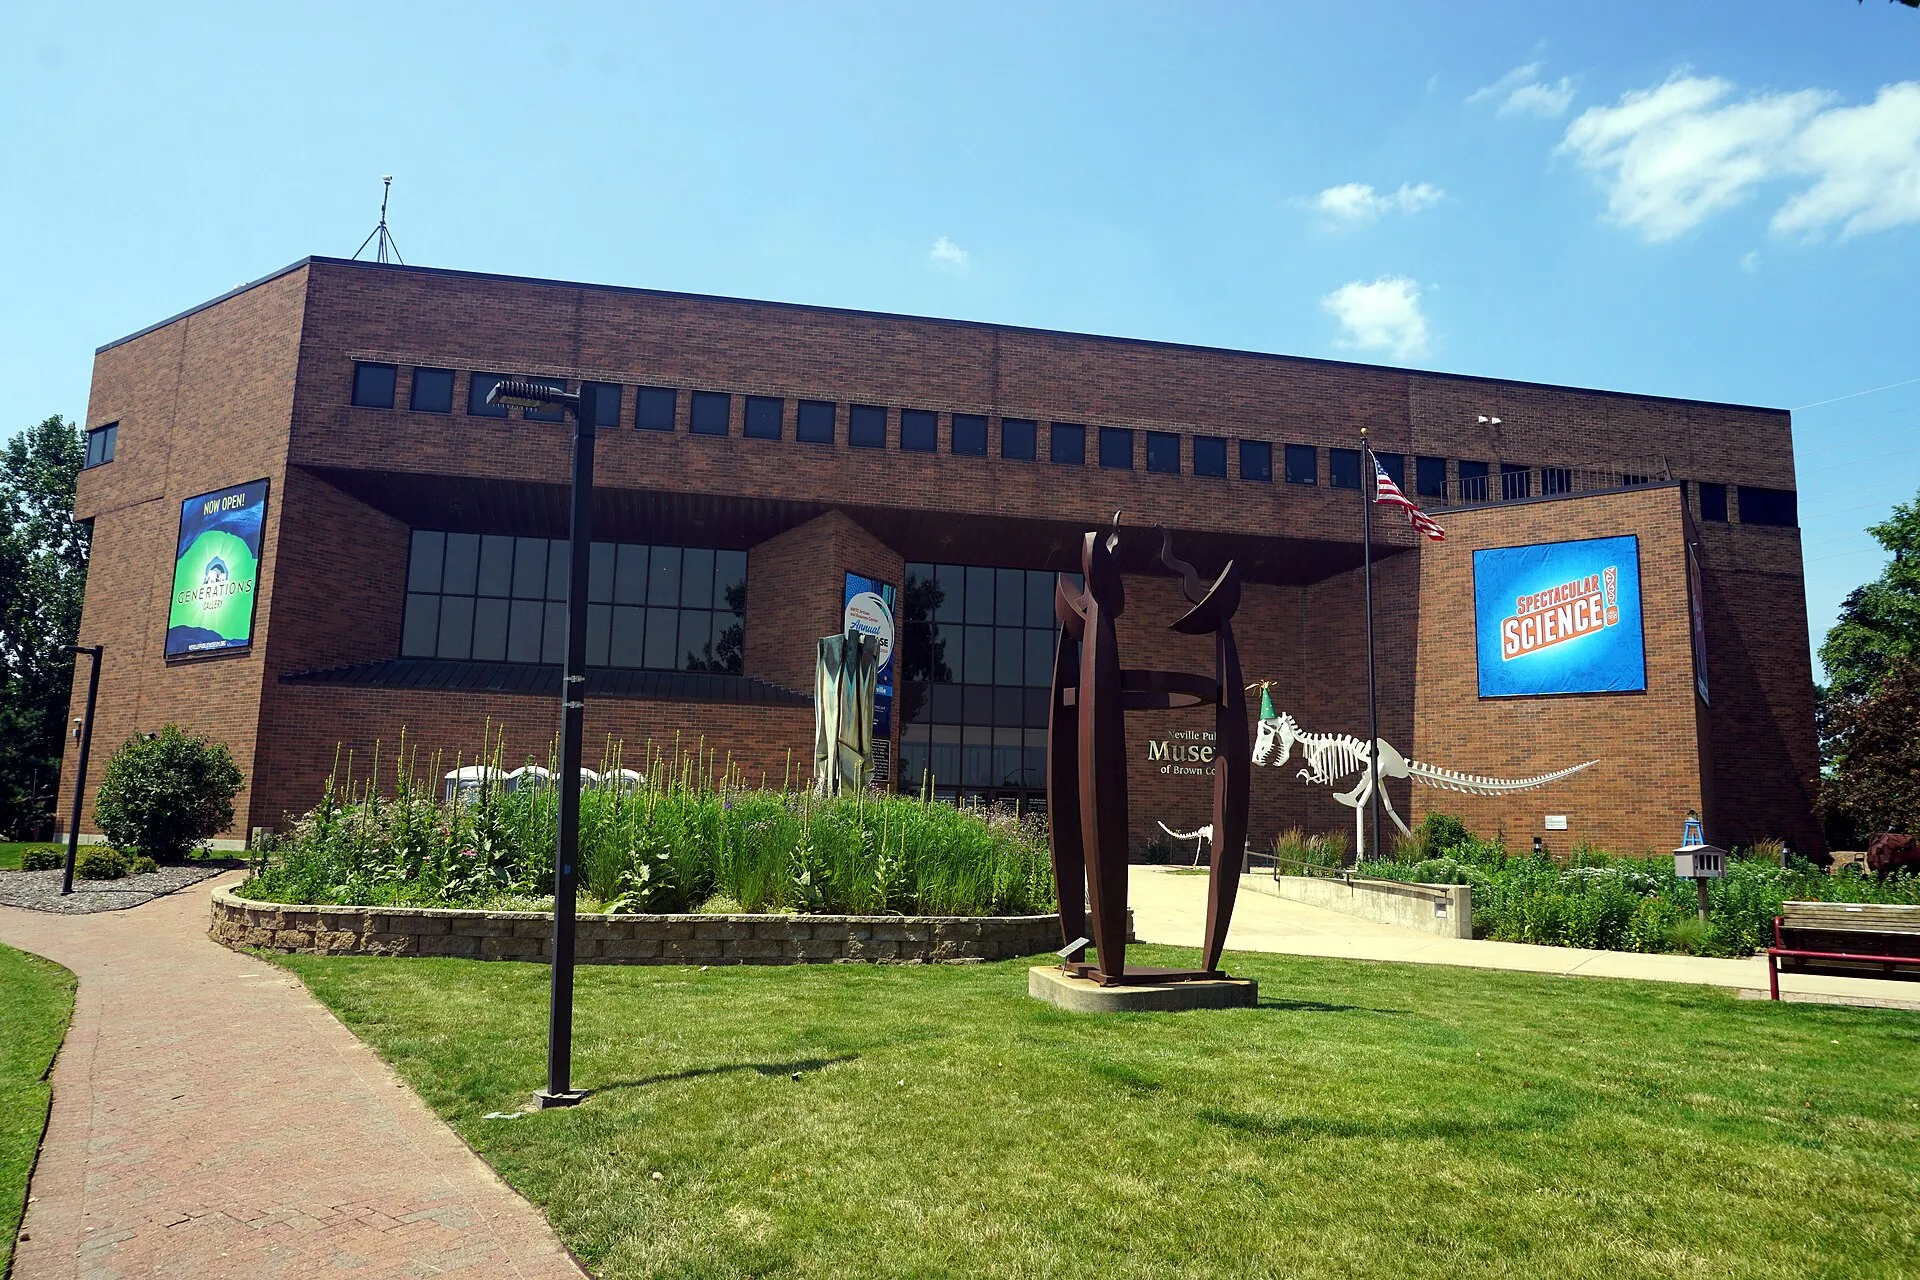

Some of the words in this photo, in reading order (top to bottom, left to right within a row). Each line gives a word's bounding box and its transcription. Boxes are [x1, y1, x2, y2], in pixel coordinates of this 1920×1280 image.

[204, 500, 220, 515] NOW
[222, 493, 246, 511] OPEN!
[177, 579, 252, 604] GENERATIONS
[1517, 574, 1599, 615] SPECTACULAR
[203, 599, 223, 611] GALLERY
[850, 620, 881, 635] Annual
[1168, 730, 1200, 740] Neville
[1147, 740, 1216, 763] Muse
[1160, 764, 1171, 774] of
[1173, 765, 1202, 775] Brown
